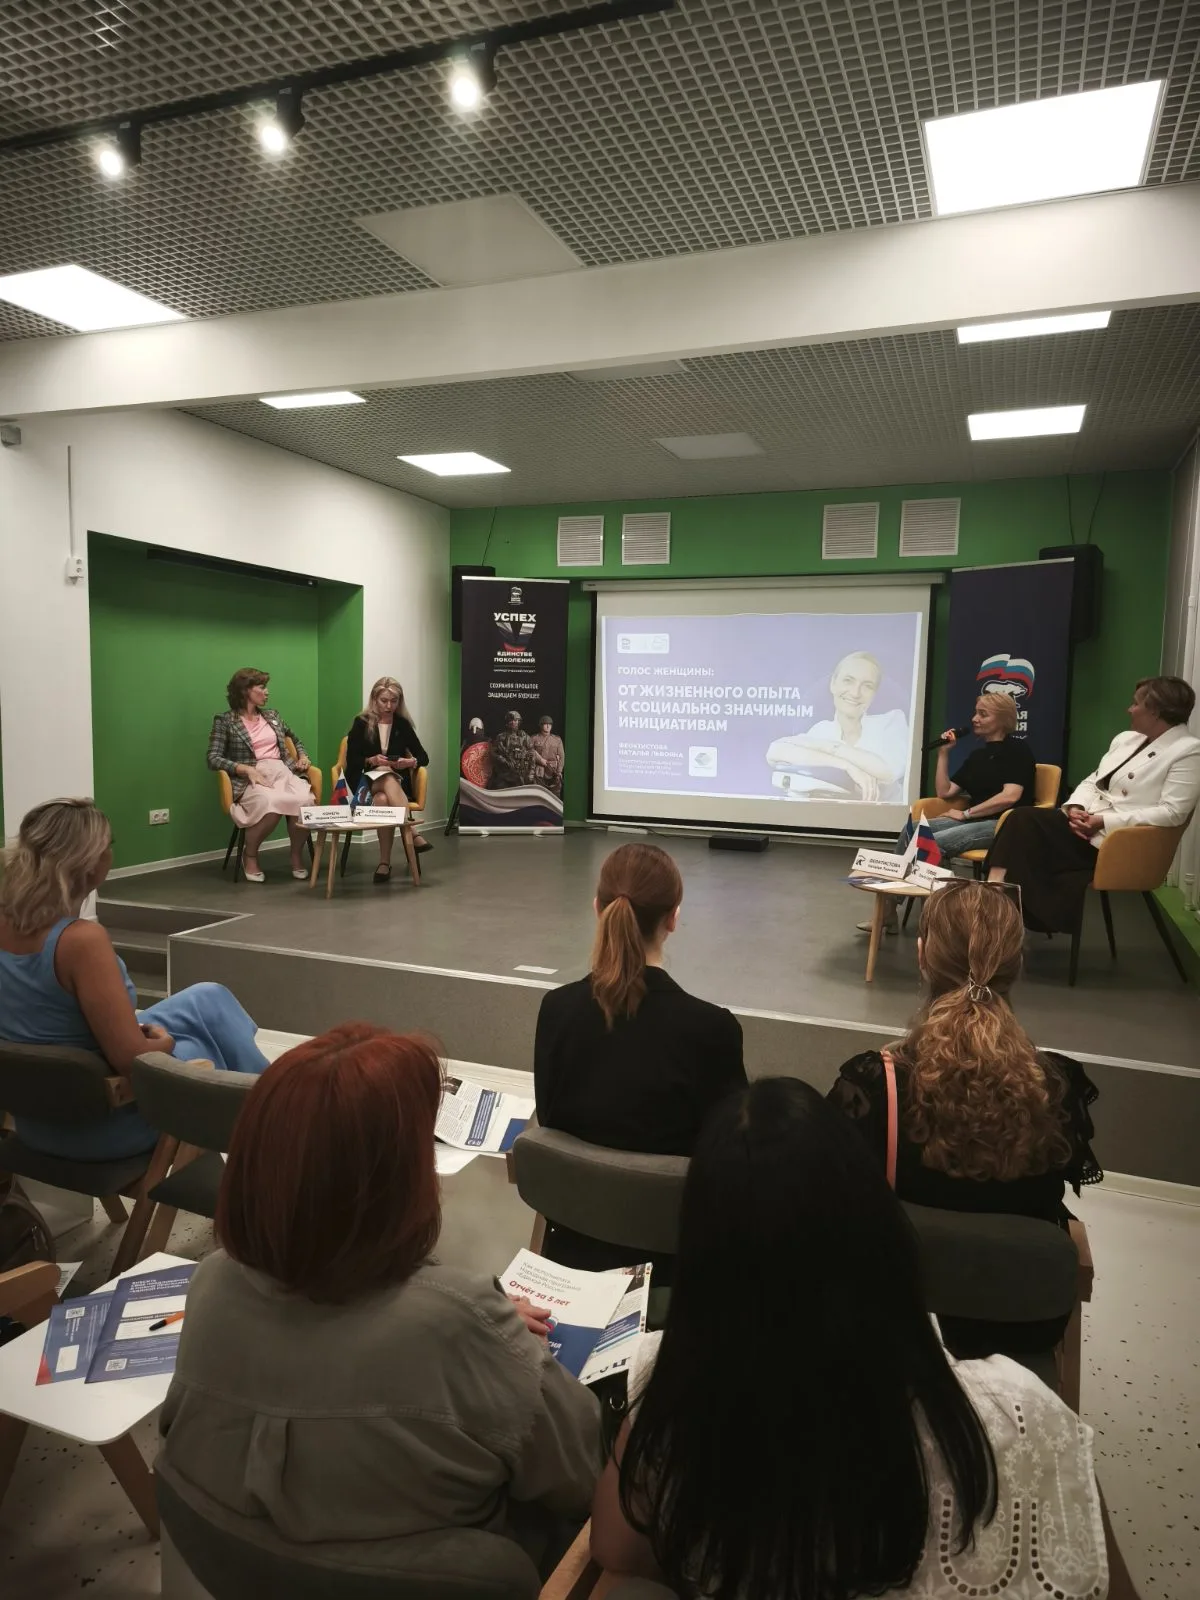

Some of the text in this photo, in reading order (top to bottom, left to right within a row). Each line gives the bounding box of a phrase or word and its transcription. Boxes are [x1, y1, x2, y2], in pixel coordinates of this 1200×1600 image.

[494, 612, 536, 622] УСПЕХ
[618, 666, 714, 677] ГОЛОС ЖЕНЩИНЫ:
[618, 685, 800, 700] ОТ ЖИЗНЕННОГО ОПЫТА
[618, 701, 814, 718] К СОЦИАЛЬНО ЗНАЧИМЫМ
[618, 716, 728, 732] ИНИЦИАТИВАМ
